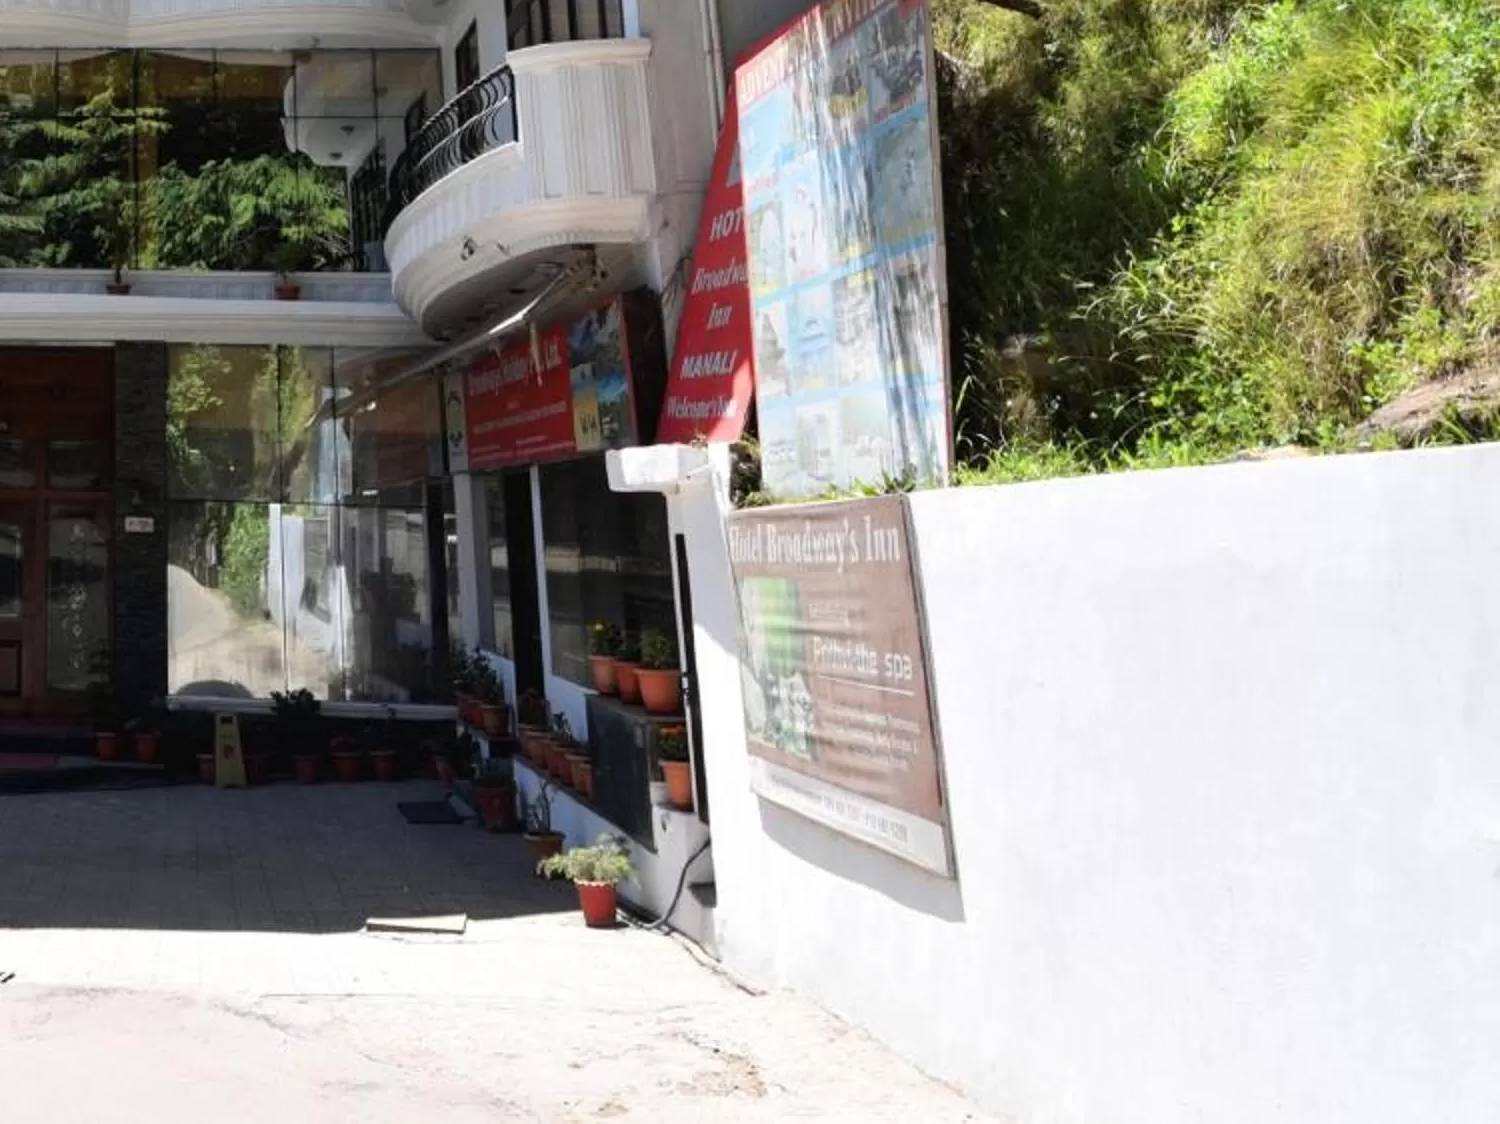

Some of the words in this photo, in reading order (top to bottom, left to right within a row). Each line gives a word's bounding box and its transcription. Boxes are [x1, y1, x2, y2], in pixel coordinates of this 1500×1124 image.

[709, 210, 744, 242] HOT
[692, 257, 749, 294] Broadwa
[707, 303, 733, 329] Inn
[680, 349, 739, 379] MANALI
[864, 515, 901, 563] Inn
[884, 652, 913, 683] spa
